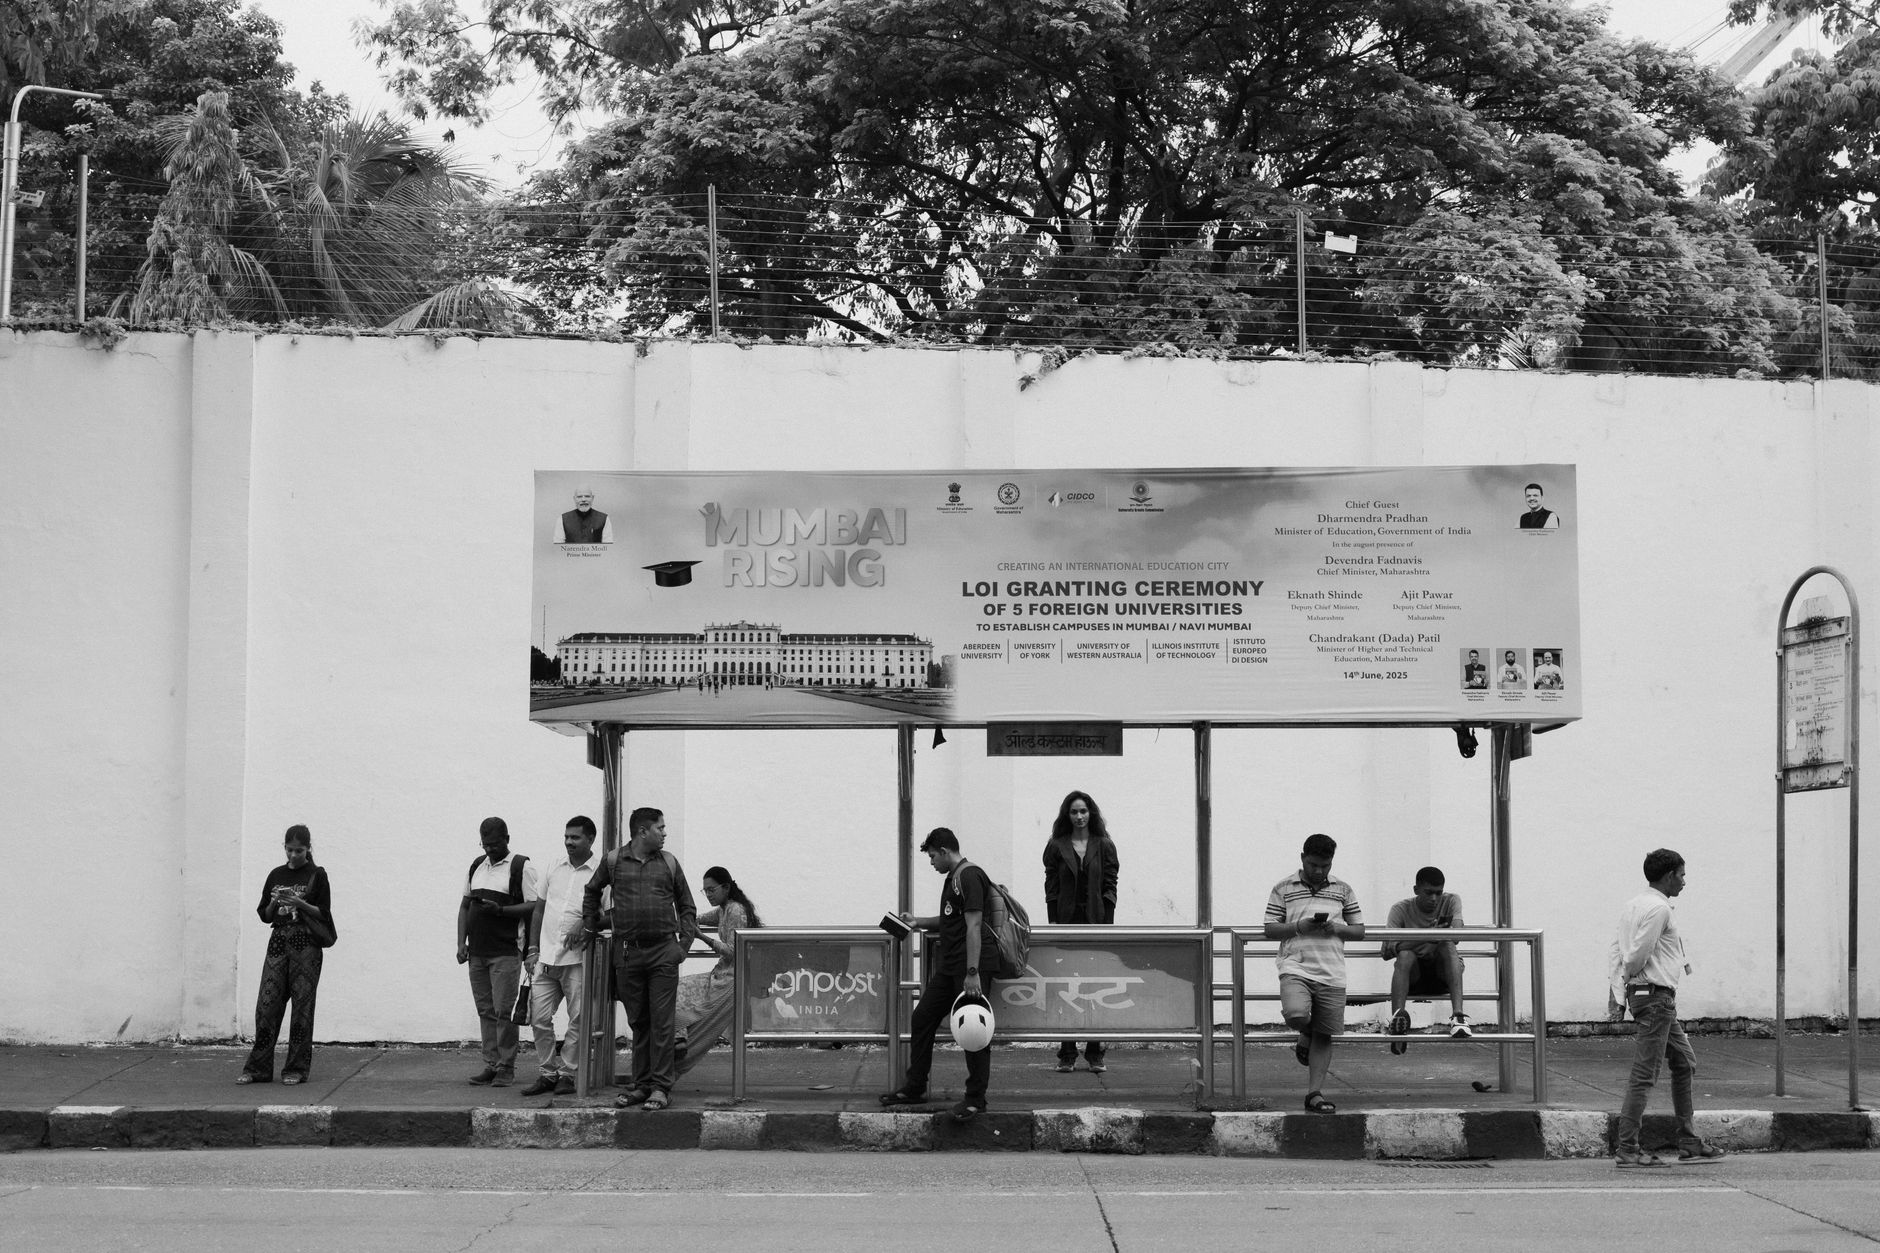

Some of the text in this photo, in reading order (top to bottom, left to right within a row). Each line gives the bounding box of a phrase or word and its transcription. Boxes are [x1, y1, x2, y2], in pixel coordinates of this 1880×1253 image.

[1066, 492, 1095, 500] CIDCO
[1345, 500, 1399, 509] Chief Guest
[1317, 513, 1428, 523] Dharmendra Pradhan
[704, 506, 907, 547] MUMBAI
[1274, 527, 1472, 537] Minister of Education, Government of India
[1325, 555, 1422, 565] Devendra Fadnavis
[724, 548, 885, 588] RISING
[997, 562, 1230, 571] CREATING AN INTERNATIONAL EDUCATION CITY
[1316, 567, 1430, 577] Chief Minister, Maharashtra
[962, 580, 1265, 597] LOI GRANTING CEREMONY
[1287, 590, 1363, 600] Eknath Shinde
[1400, 590, 1454, 602] Ajit Pawar
[983, 603, 1243, 616] OF 5 FOREIGN UNIVERSITIES
[976, 623, 992, 632] TO
[993, 623, 1051, 632] ESTABLISH
[1052, 623, 1111, 632] CAMPUSES
[1112, 623, 1124, 632] IN
[1125, 623, 1170, 632] MUMBAI
[1179, 623, 1206, 632] NAVI
[1207, 622, 1252, 632] MUMBAI
[1233, 638, 1266, 646] ISTITUTO
[1308, 633, 1441, 645] Chandrakant (Dada) Patil
[962, 643, 1001, 651] ABERDEEN
[1232, 647, 1267, 655] EUROPEO
[1316, 645, 1434, 654] Minister of Higher and Technical
[961, 652, 1003, 660] UNIVERSITY
[1231, 656, 1268, 664] DI DESIGN
[1334, 655, 1373, 663] Education,
[1360, 671, 1384, 681] June,
[1386, 671, 1408, 680] 2025
[799, 1005, 839, 1015] INDIA
